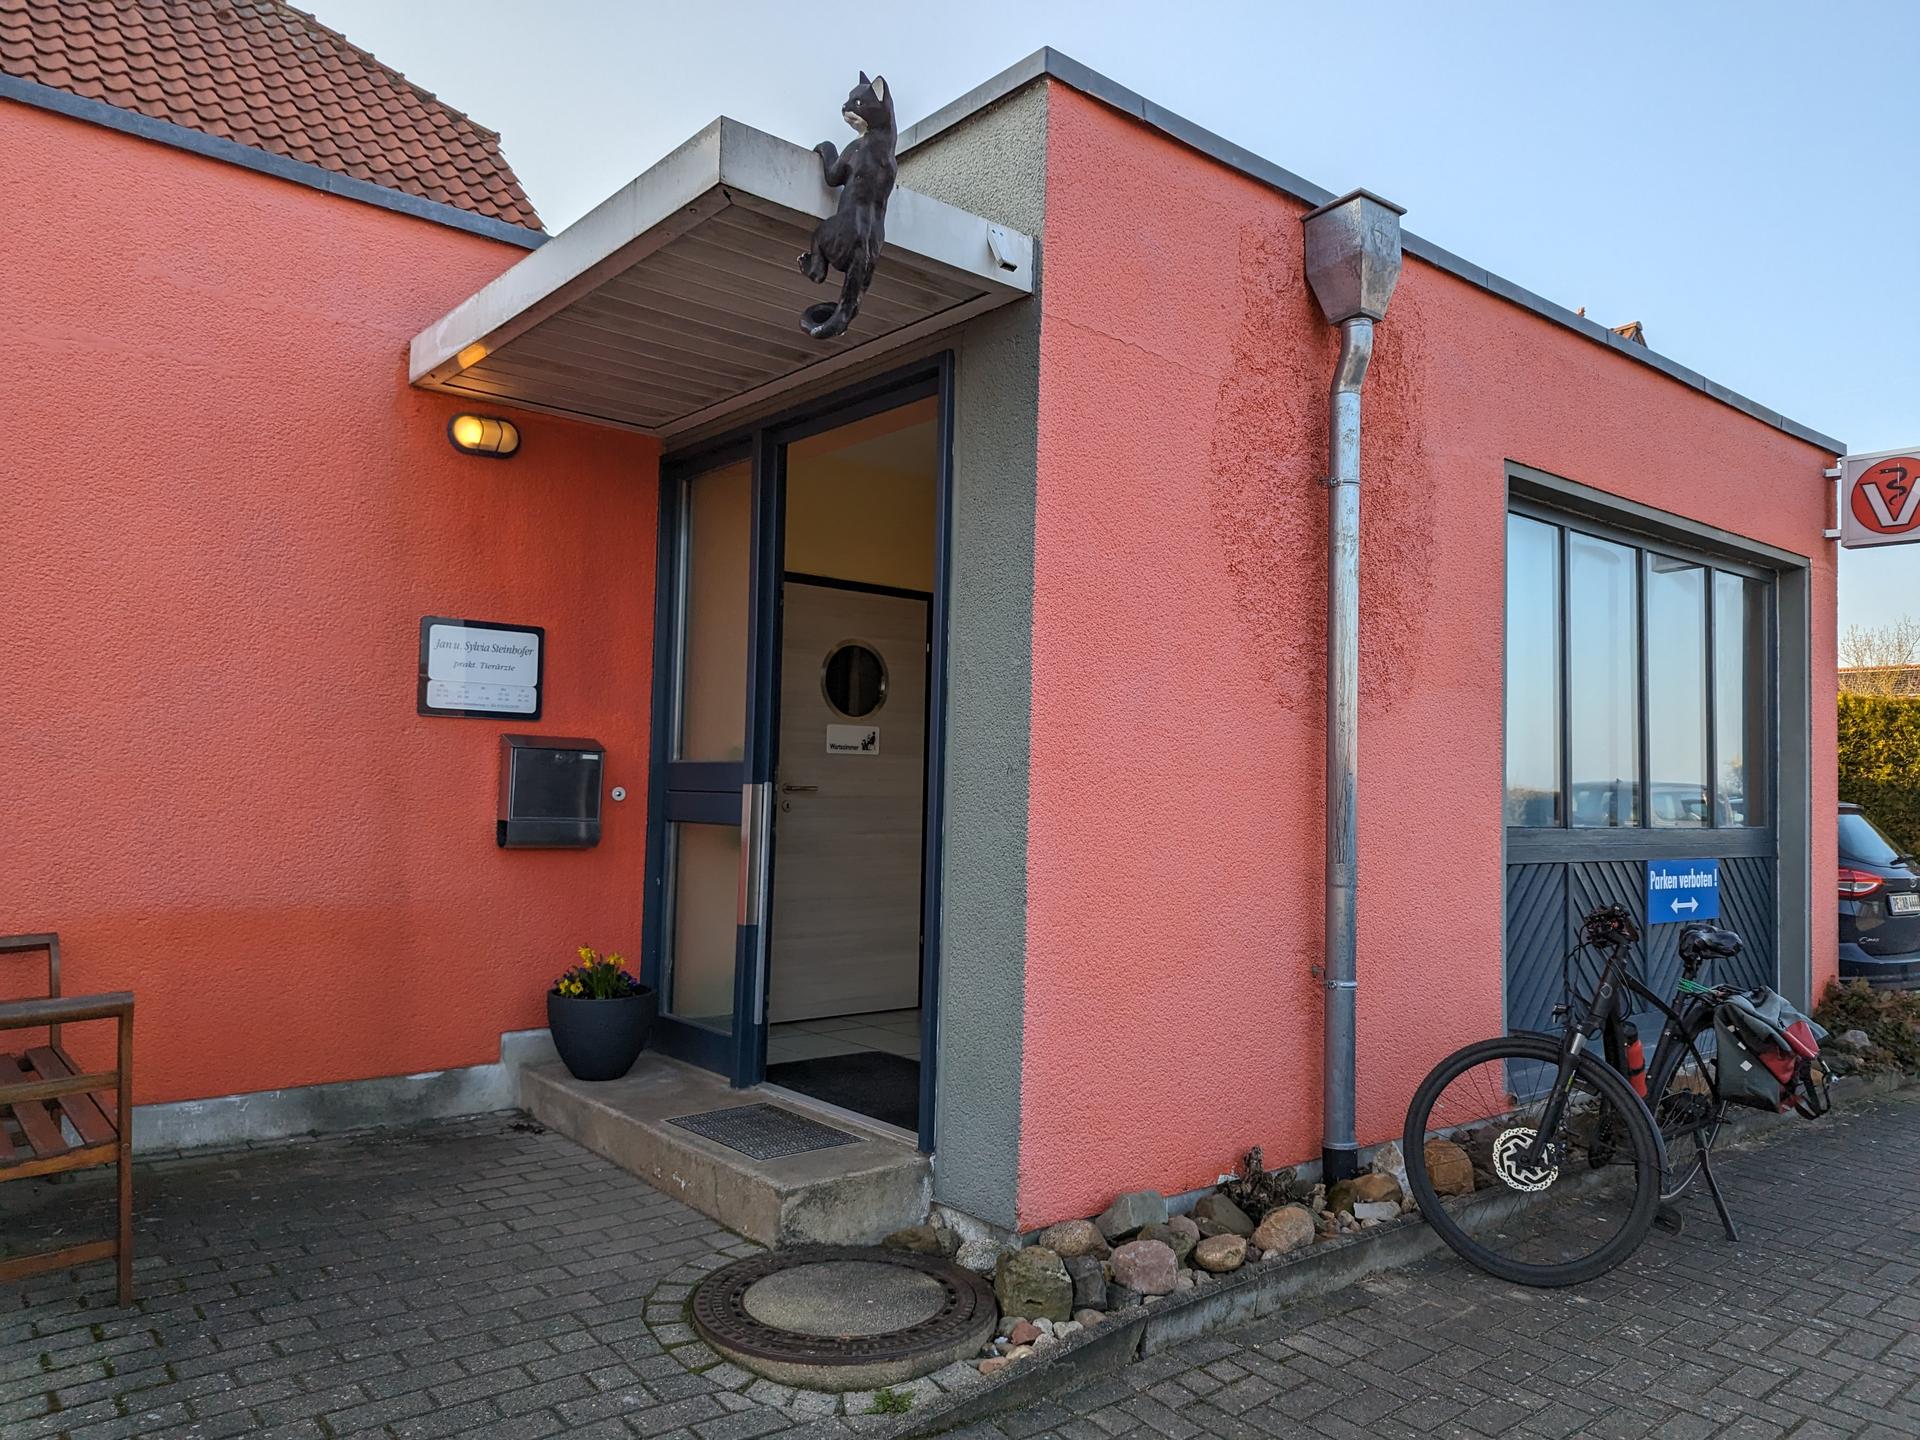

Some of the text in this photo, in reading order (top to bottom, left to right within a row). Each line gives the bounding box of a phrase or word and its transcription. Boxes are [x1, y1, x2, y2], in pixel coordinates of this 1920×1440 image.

[434, 638, 452, 650] Jan
[464, 641, 490, 653] Sylvia
[491, 643, 535, 658] Steinhofer
[480, 661, 516, 671] Tierärzte
[1650, 869, 1677, 890] Parken
